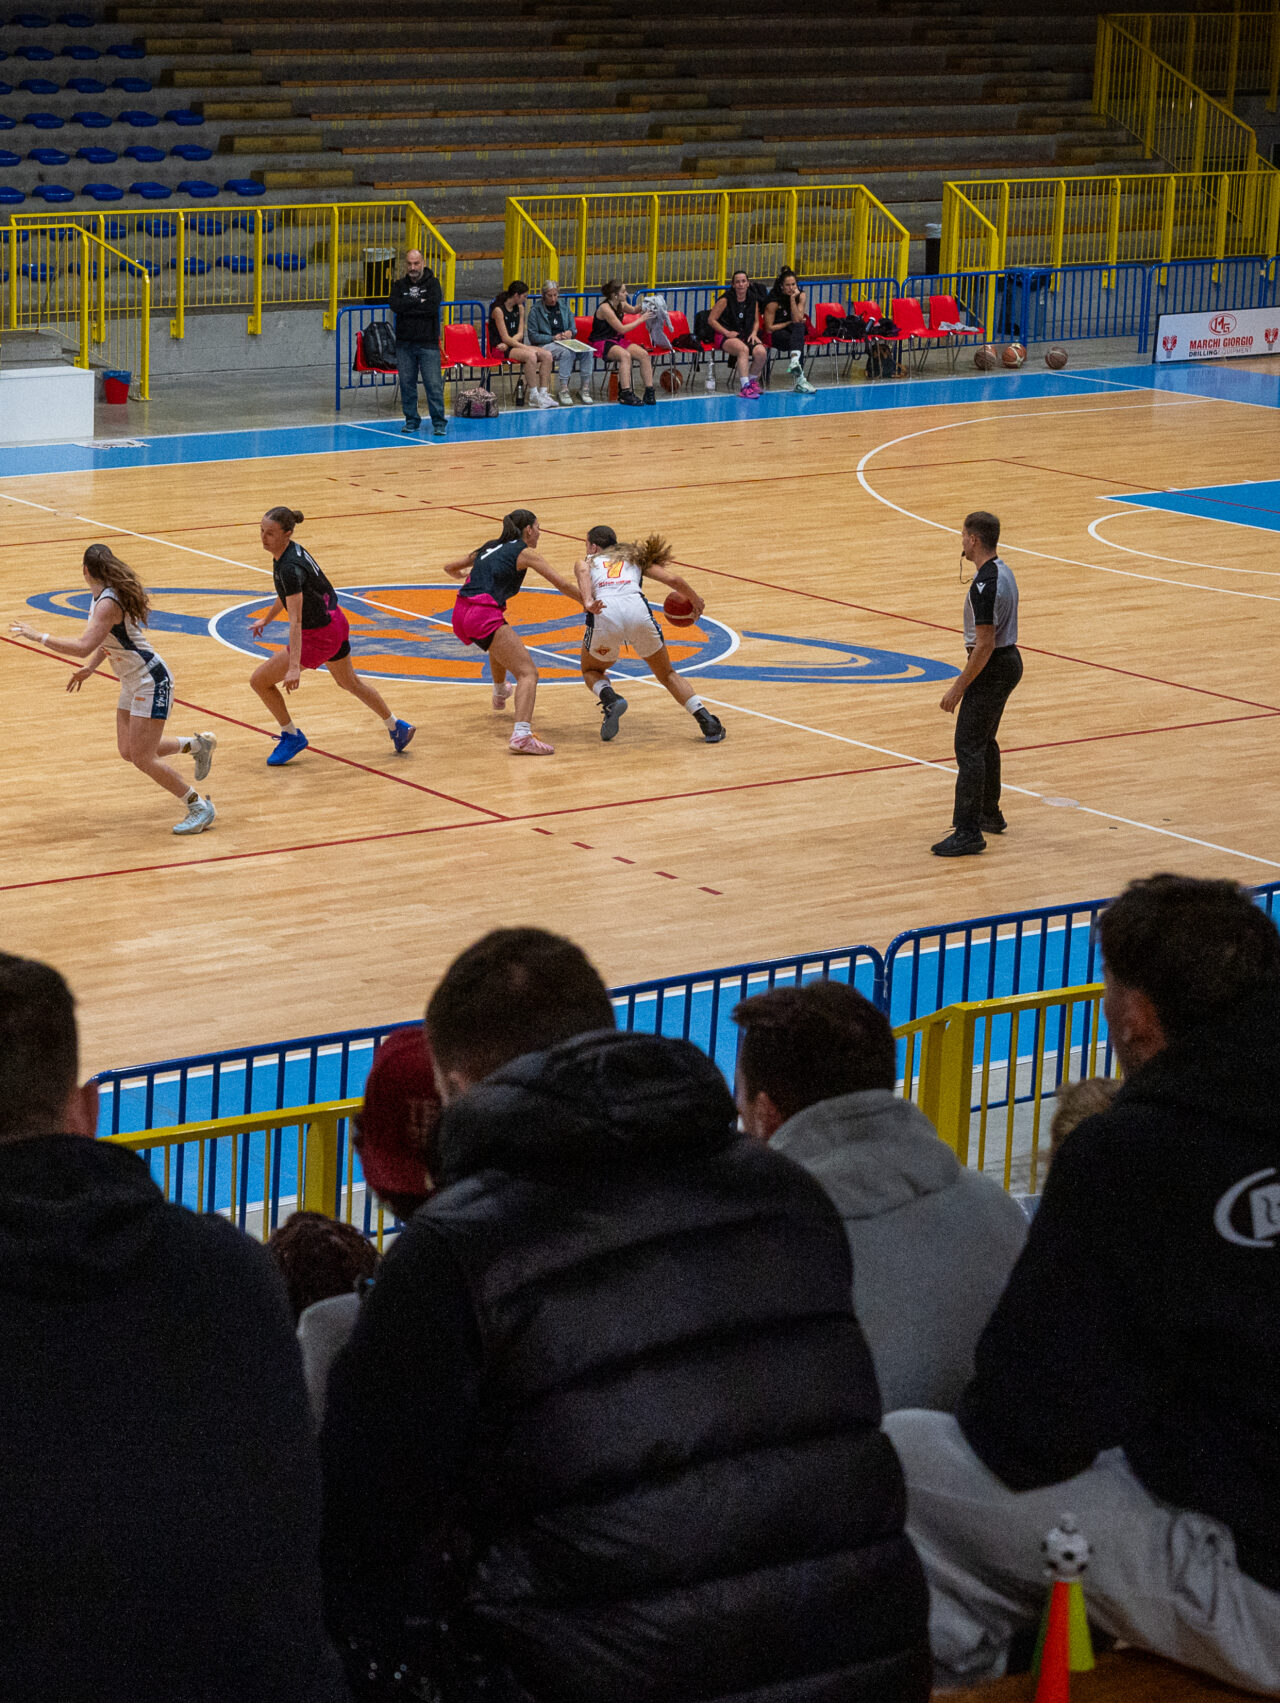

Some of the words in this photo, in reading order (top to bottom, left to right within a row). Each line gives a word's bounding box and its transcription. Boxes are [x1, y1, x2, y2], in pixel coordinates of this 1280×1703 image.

[1189, 339, 1220, 350] MARCHI
[1223, 336, 1254, 348] GIORGIO
[1188, 349, 1218, 357] DRILLING
[603, 560, 624, 578] 7
